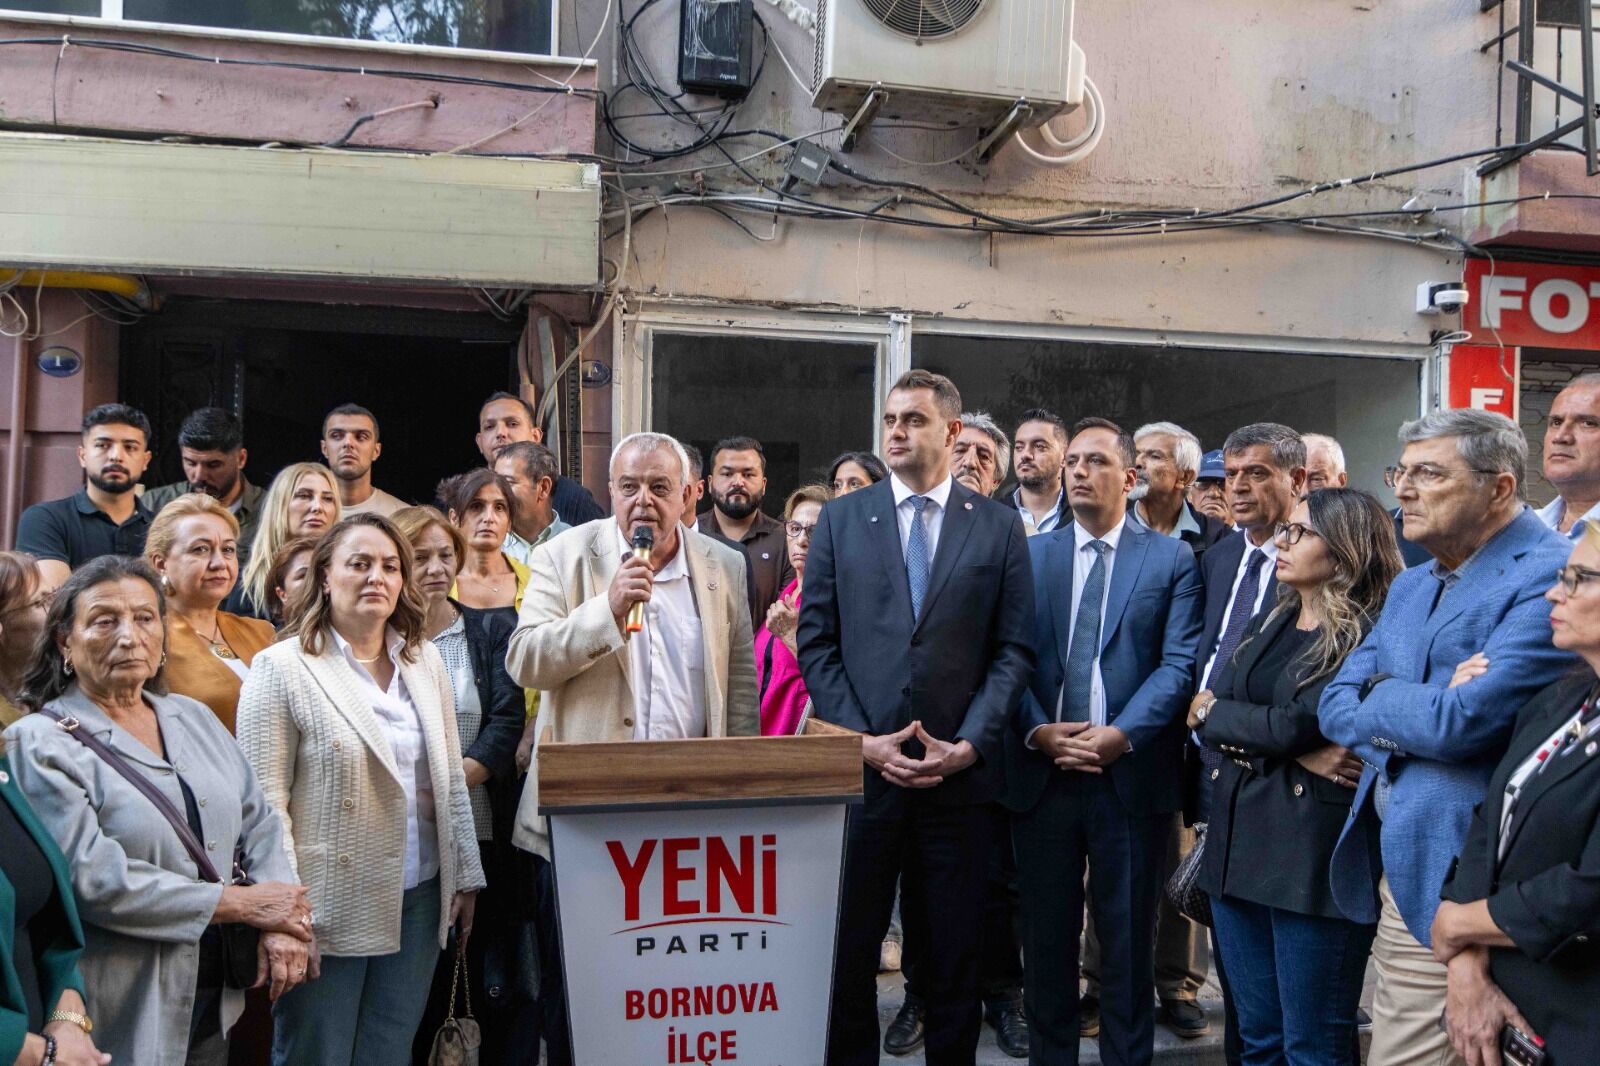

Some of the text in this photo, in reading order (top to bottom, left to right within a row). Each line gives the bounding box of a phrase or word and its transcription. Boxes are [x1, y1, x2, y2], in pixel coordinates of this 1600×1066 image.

[1480, 275, 1600, 334] FO
[625, 982, 779, 1020] BORNOVA
[667, 1026, 737, 1066] İLÇE
